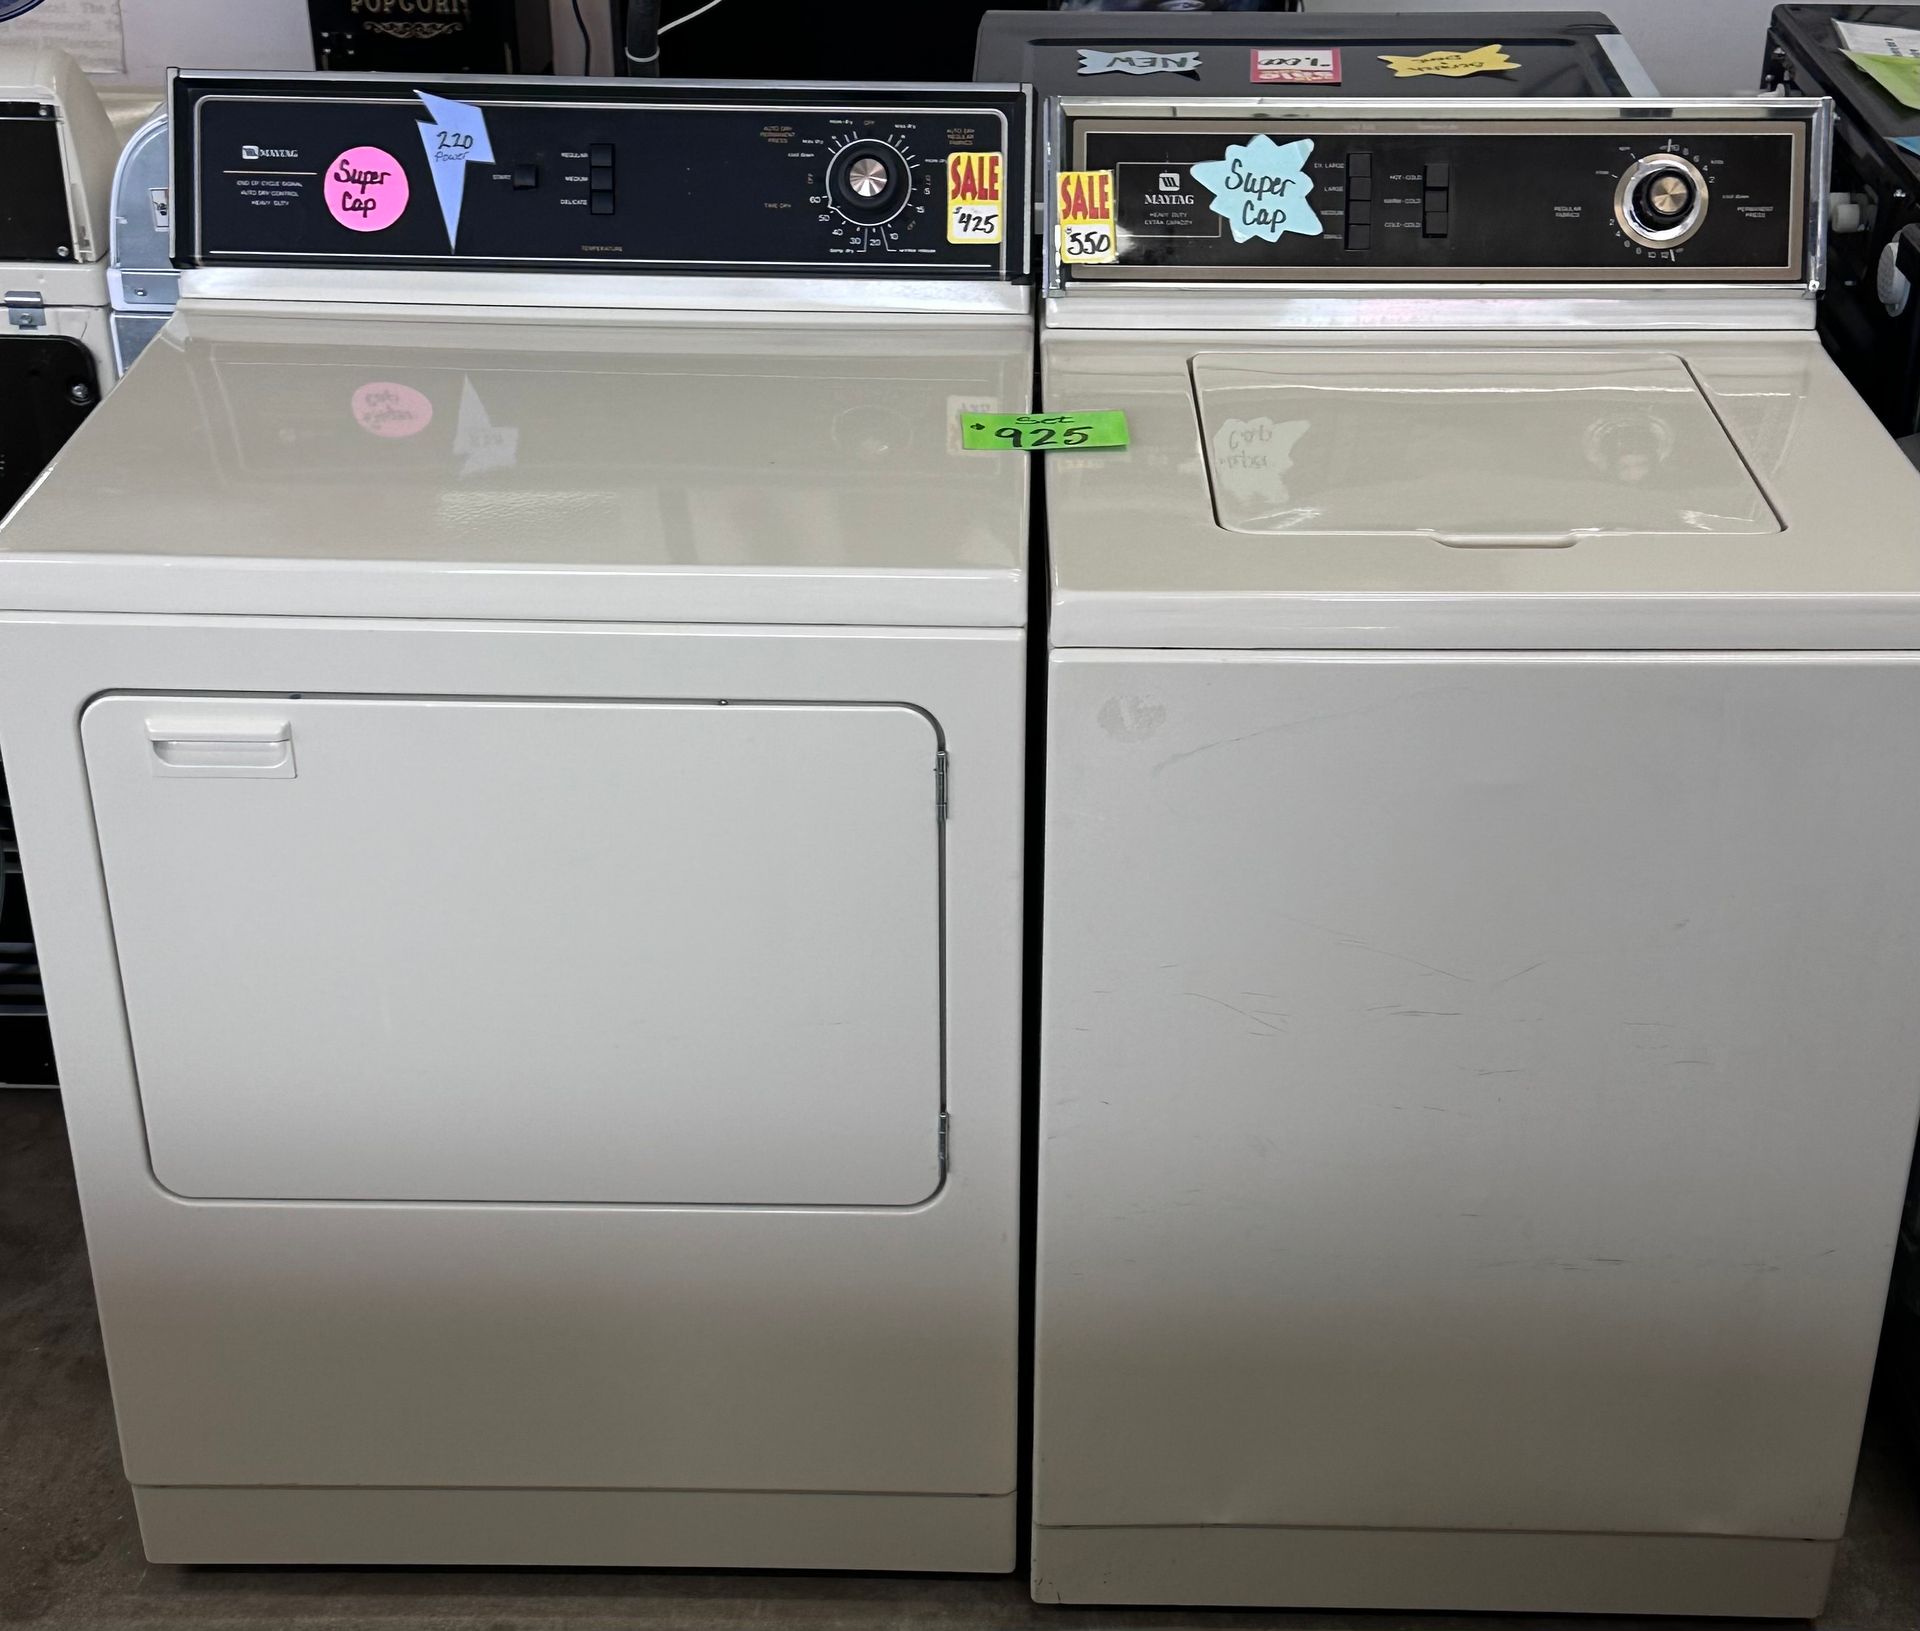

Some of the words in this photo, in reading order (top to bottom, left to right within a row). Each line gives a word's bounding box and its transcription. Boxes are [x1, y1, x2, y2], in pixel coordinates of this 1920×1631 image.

[1106, 57, 1187, 68] NEW
[436, 131, 474, 150] 220
[333, 159, 392, 195] Super
[950, 155, 1000, 201] SALE
[1224, 158, 1297, 202] Super
[341, 191, 377, 219] Cap
[809, 195, 822, 204] 60
[1061, 174, 1110, 220] SALE
[1144, 194, 1195, 206] MAYTAG
[818, 214, 830, 222] 50
[1242, 199, 1287, 233] Cap
[849, 237, 861, 245] 30
